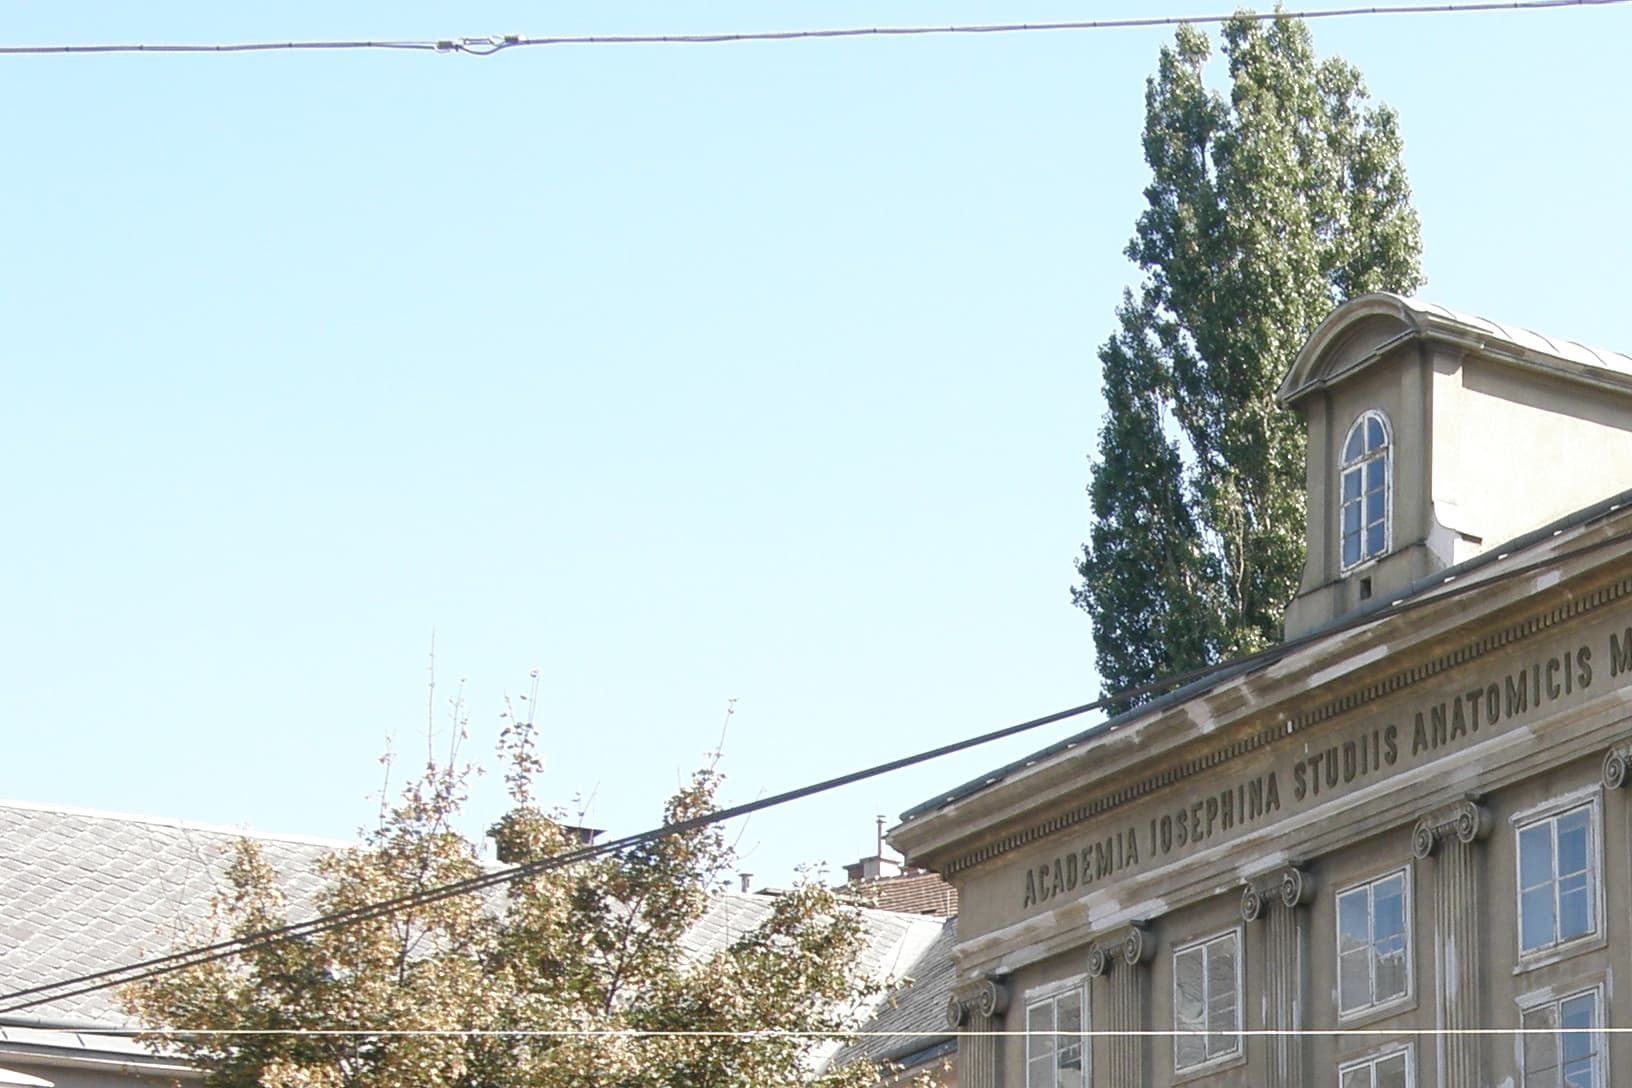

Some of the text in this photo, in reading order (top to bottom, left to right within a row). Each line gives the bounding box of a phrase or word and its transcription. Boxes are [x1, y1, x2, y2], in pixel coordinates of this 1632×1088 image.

[1023, 826, 1138, 908] ACADEMIA
[1150, 771, 1281, 857] IOSEPHINA
[1294, 724, 1398, 801] STUDIIS
[1412, 645, 1593, 756] ANATOMICIS
